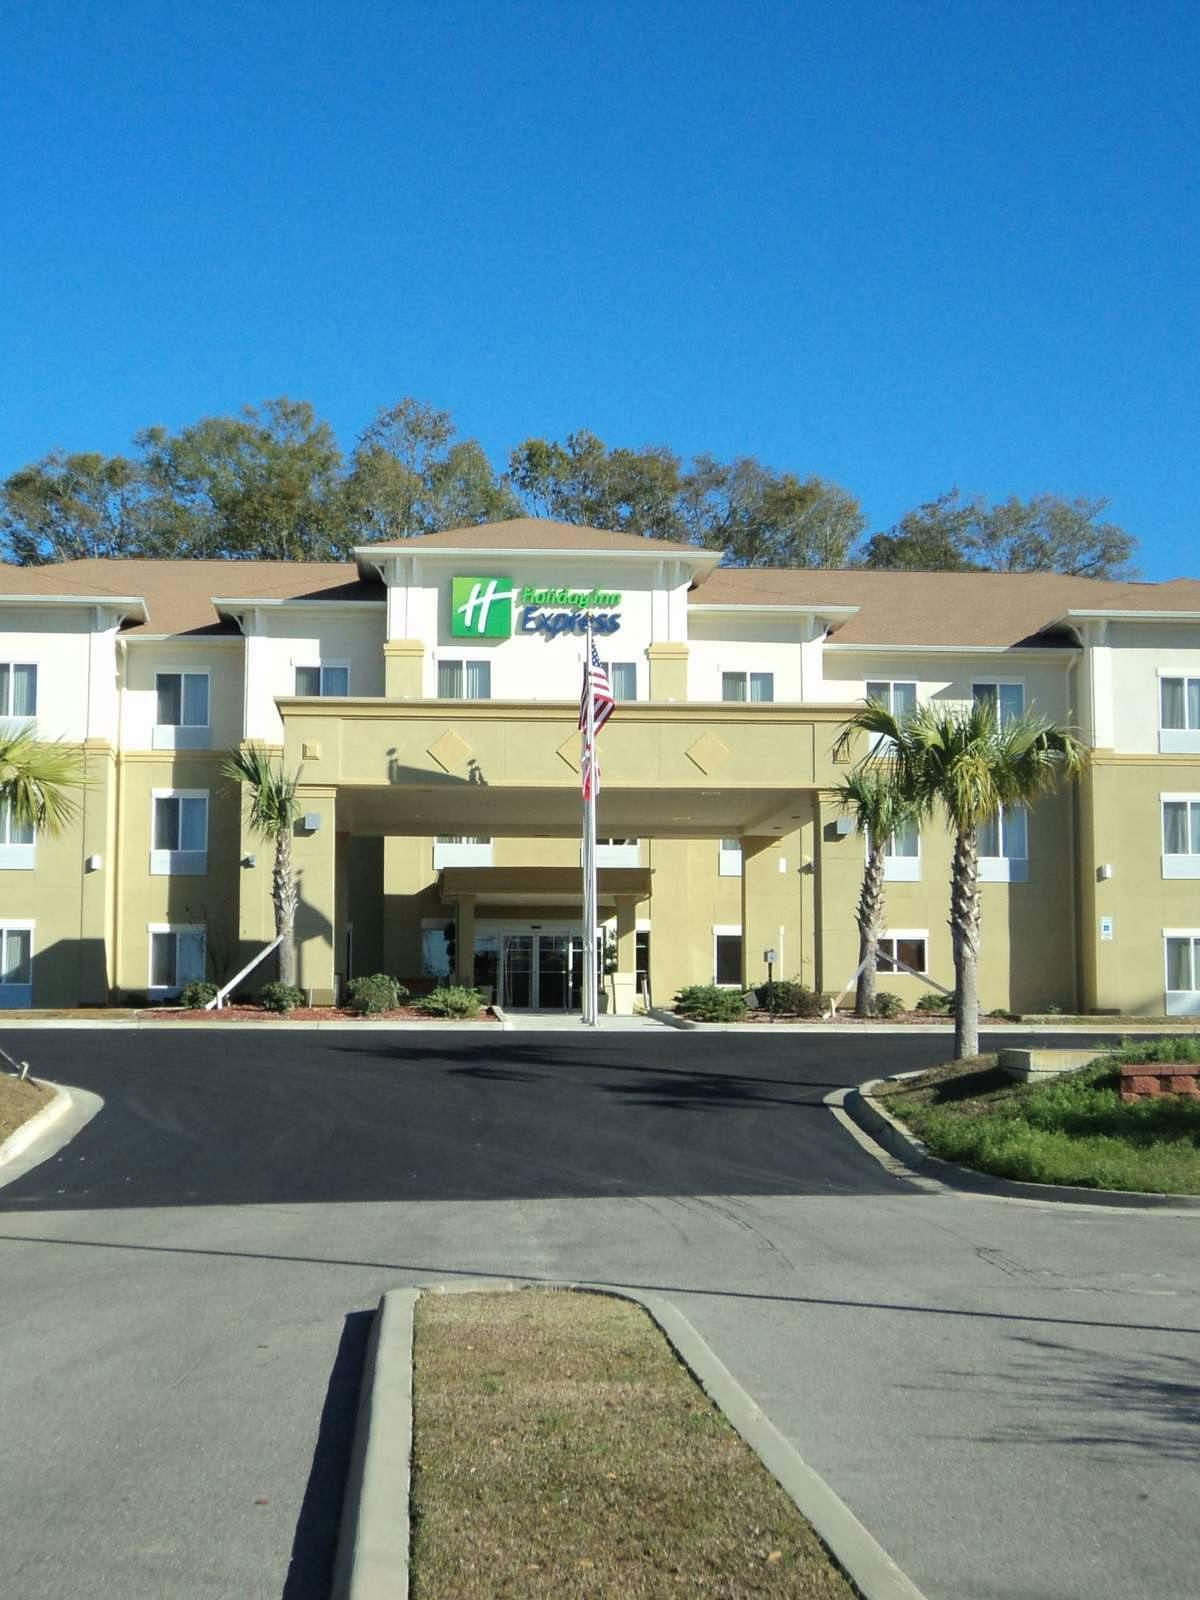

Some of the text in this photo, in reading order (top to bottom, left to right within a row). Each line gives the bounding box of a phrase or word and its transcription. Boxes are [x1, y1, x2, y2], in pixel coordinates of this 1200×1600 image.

[521, 586, 622, 608] Holiday Inn
[521, 606, 622, 637] Express
